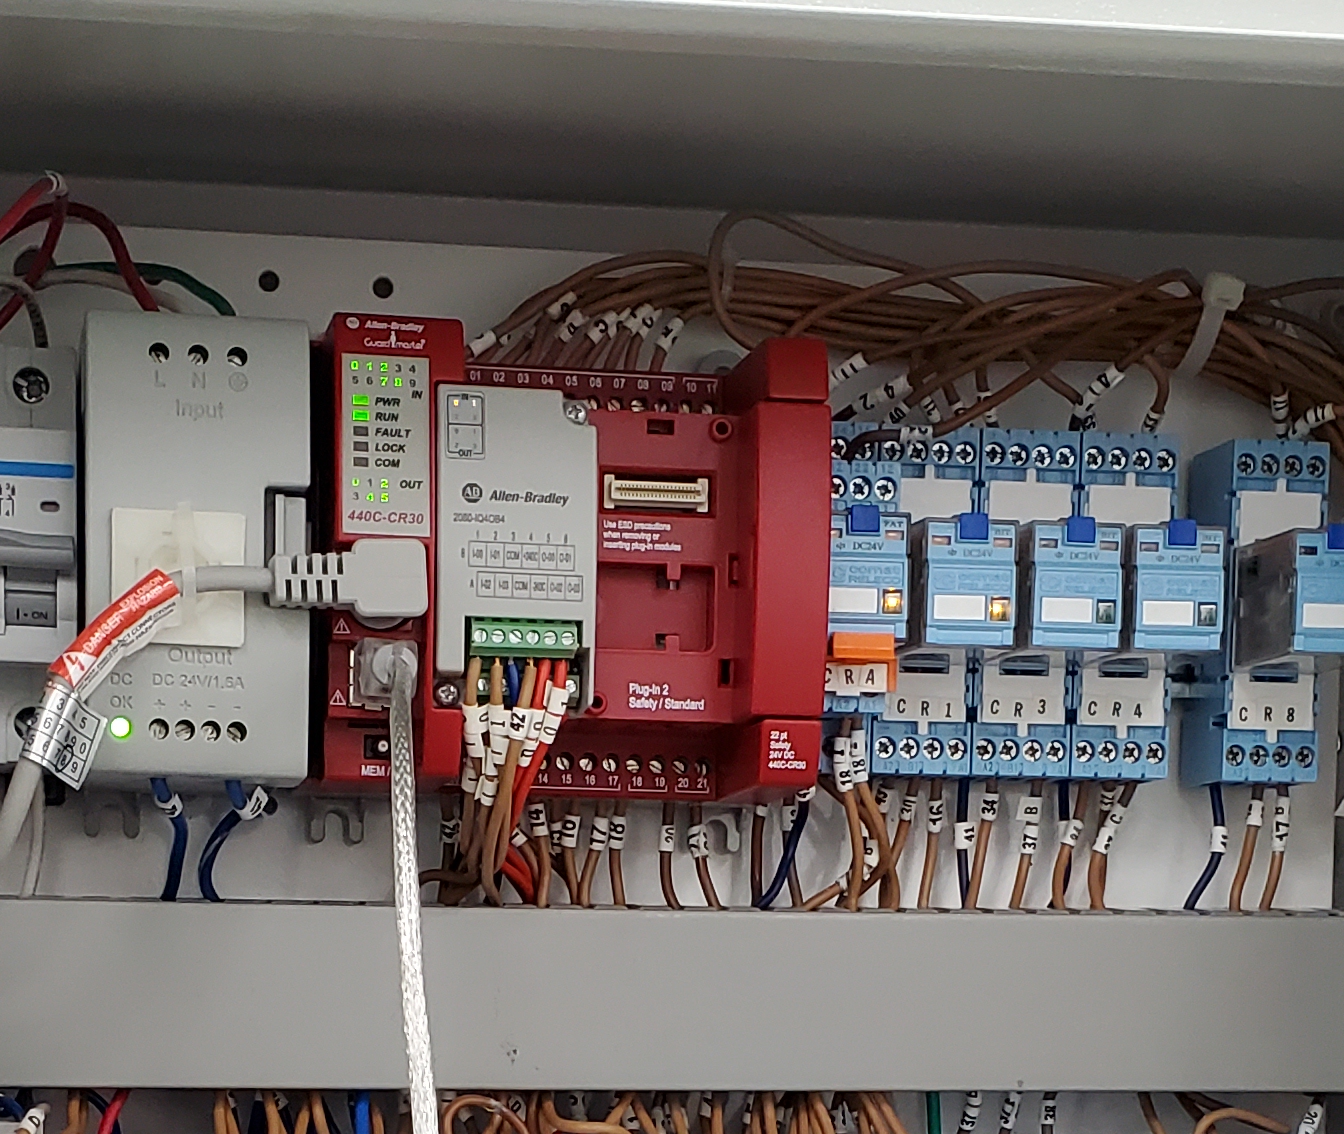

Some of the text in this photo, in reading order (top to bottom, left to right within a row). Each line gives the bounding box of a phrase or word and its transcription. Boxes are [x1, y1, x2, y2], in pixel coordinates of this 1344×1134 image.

[365, 320, 425, 333] Allen-Bradley
[493, 372, 505, 383] 02
[517, 372, 529, 384] 03
[541, 374, 553, 385] 04
[565, 375, 578, 387] 05
[613, 377, 625, 389] 07
[411, 390, 423, 400] IN
[375, 397, 401, 407] PWR
[176, 399, 223, 421] Input
[375, 412, 399, 422] RUN
[375, 428, 412, 439] FAULT
[375, 443, 406, 454] LOCK
[375, 459, 400, 468] COM
[400, 480, 423, 490] OUT
[489, 489, 569, 507] Allen-Bradley
[348, 510, 424, 525] 440C-CR30
[31, 610, 48, 620] ON
[82, 613, 125, 655] DANGER
[168, 647, 232, 668] Output
[110, 673, 133, 686] DC
[152, 673, 174, 686] DC
[662, 684, 669, 695] 2
[110, 696, 133, 709] OK
[629, 697, 704, 711] Safety Standard
[361, 765, 387, 777] MEM
[538, 774, 618, 786] 14 15 16 17
[632, 776, 642, 787] 18
